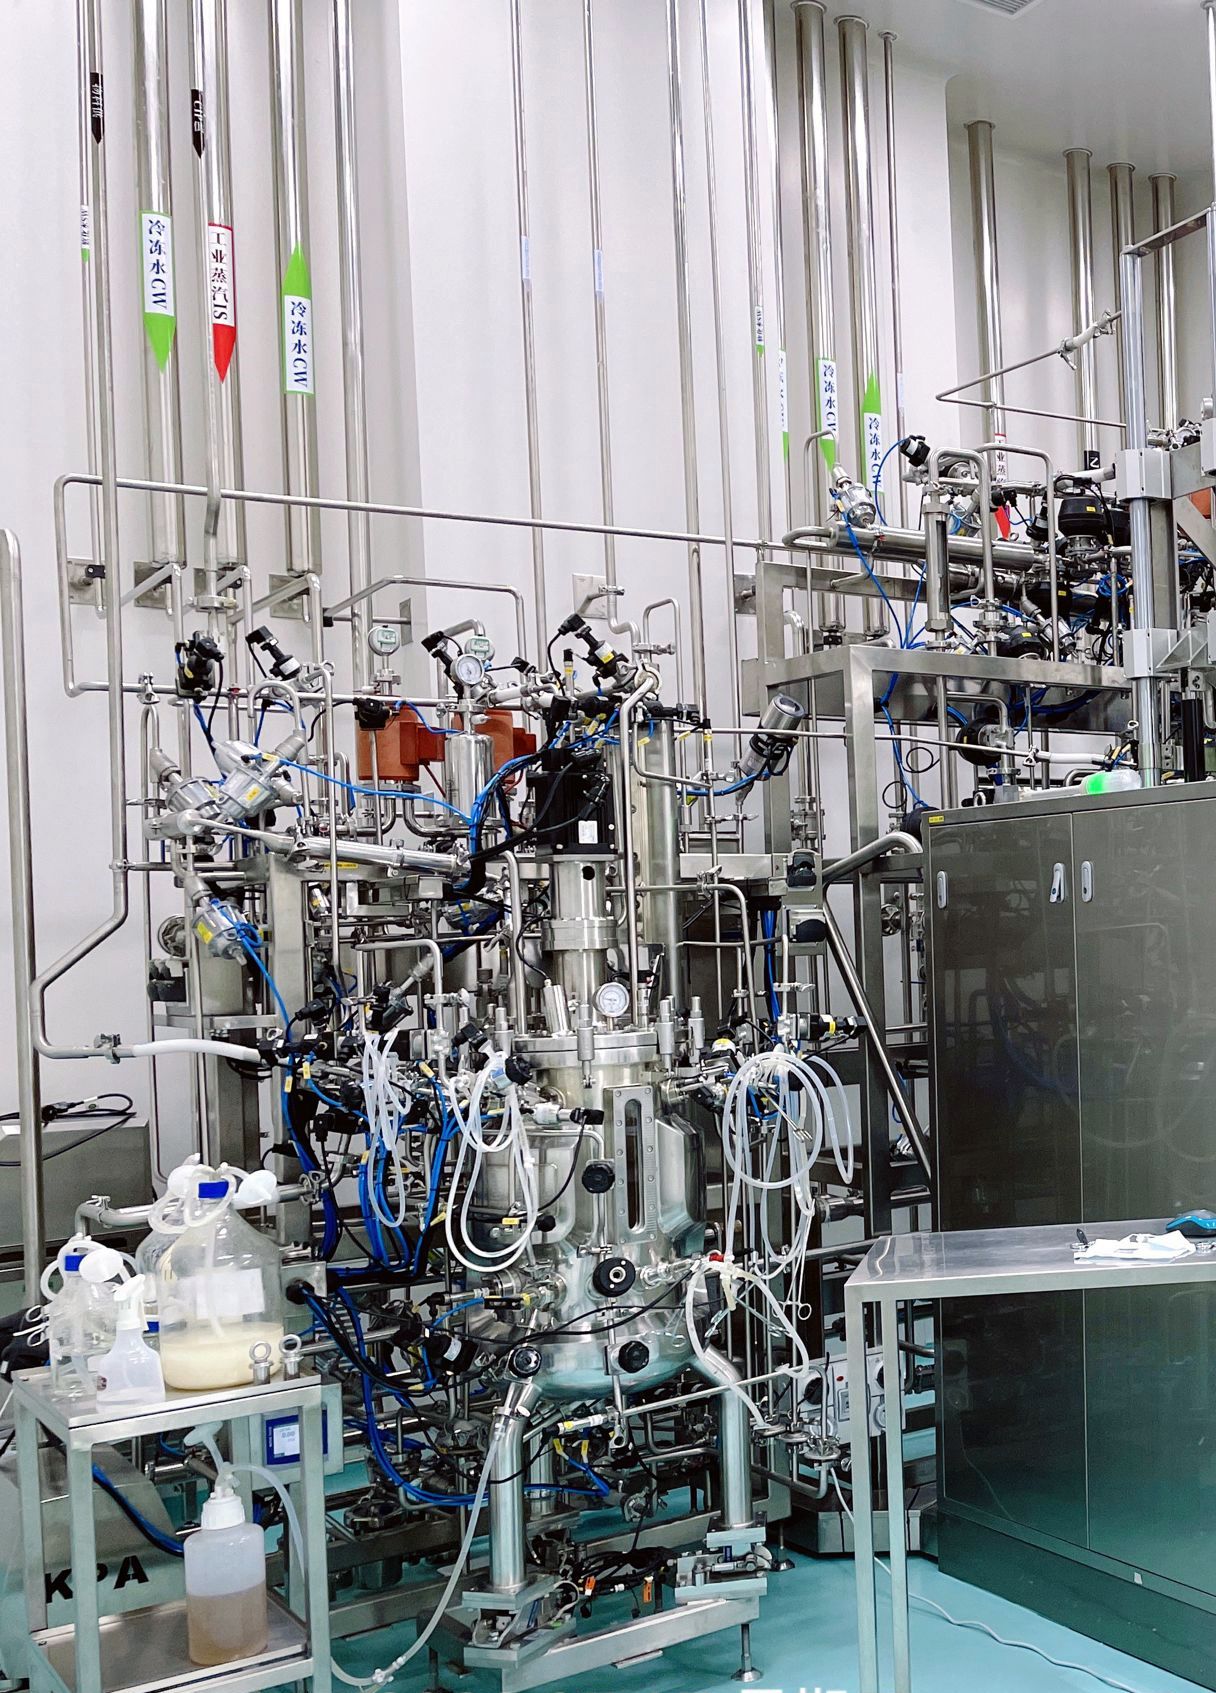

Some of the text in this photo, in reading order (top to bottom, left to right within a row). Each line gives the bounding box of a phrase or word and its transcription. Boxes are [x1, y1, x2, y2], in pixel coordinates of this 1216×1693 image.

[148, 219, 167, 309] 冷冻水CW
[211, 232, 228, 320] 工业蒸汽IS
[290, 301, 308, 387] 冷冻水CW
